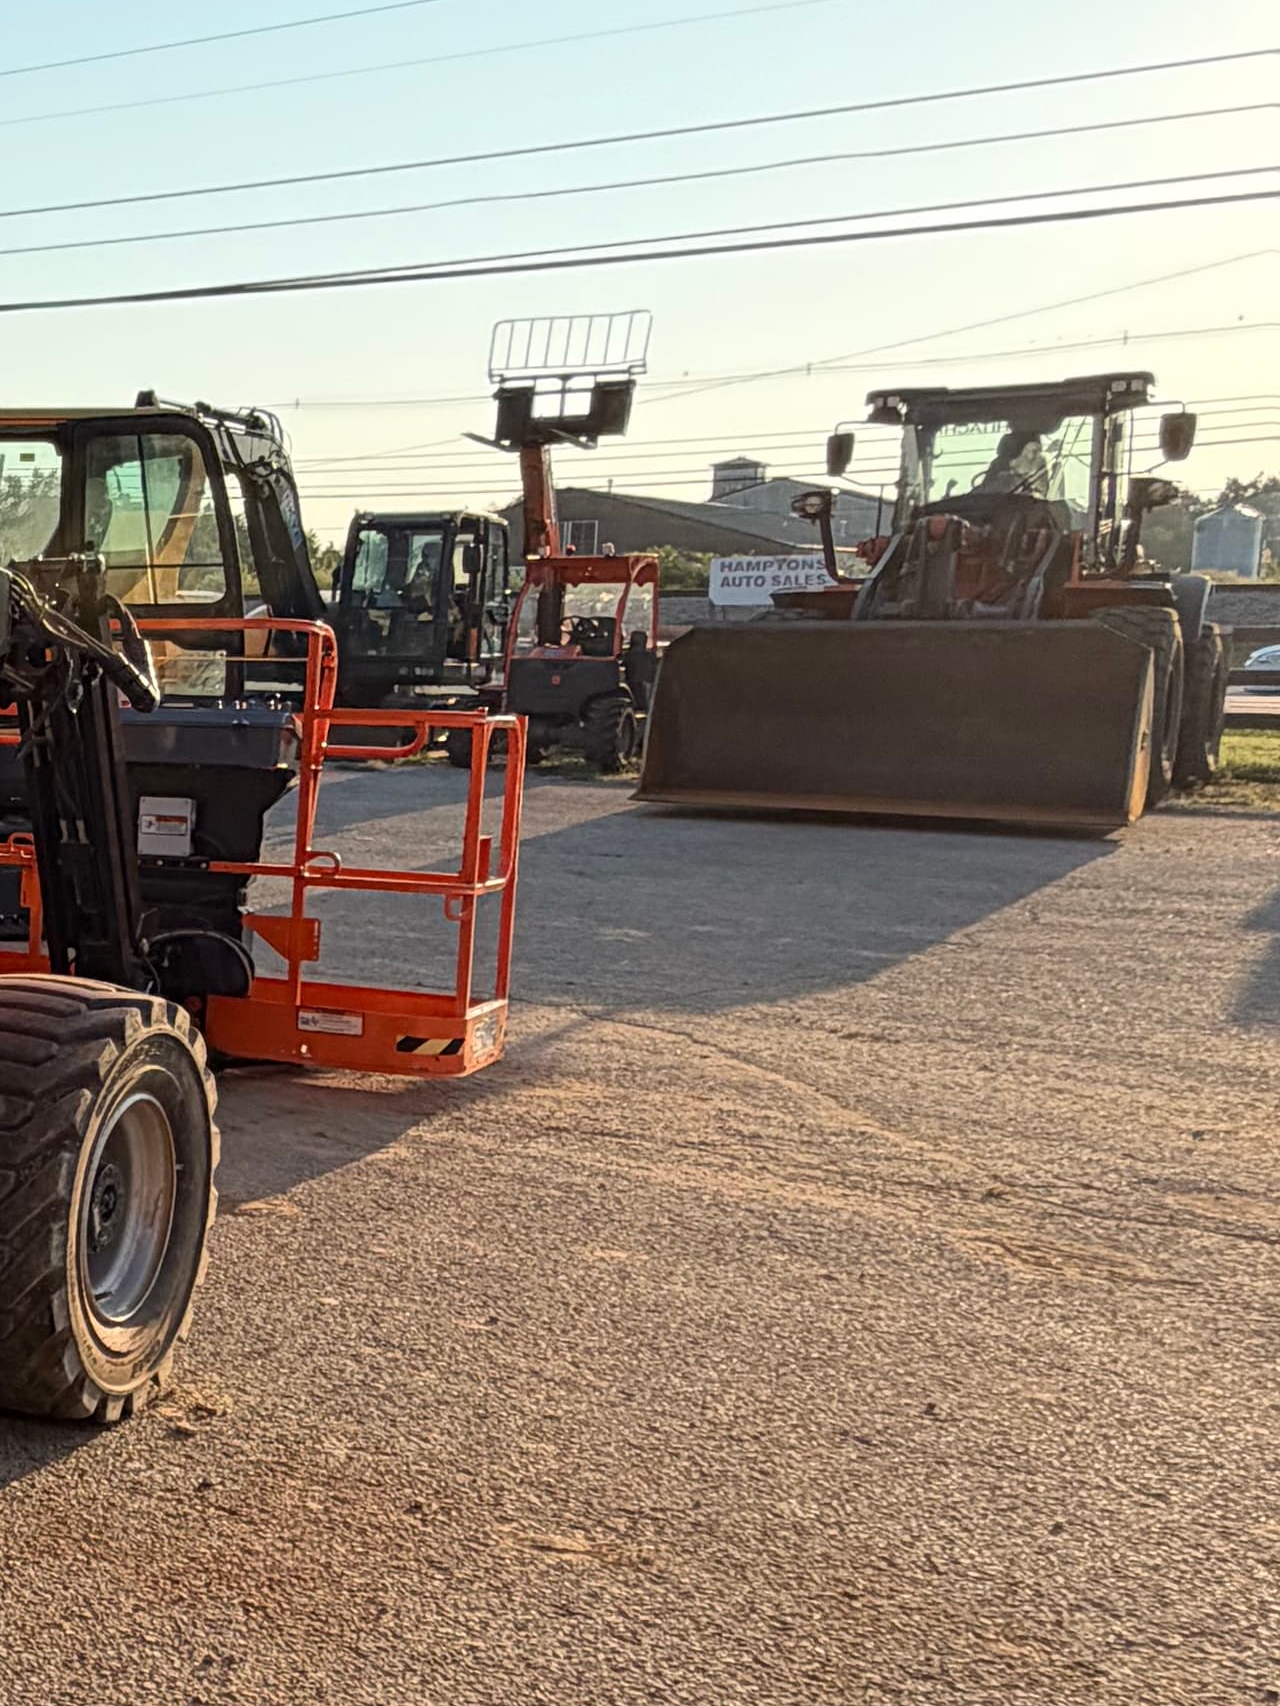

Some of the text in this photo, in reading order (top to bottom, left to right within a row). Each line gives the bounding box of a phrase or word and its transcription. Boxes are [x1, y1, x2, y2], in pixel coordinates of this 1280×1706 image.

[720, 558, 826, 573] HAMPTONS
[721, 573, 827, 588] AUTO SALES
